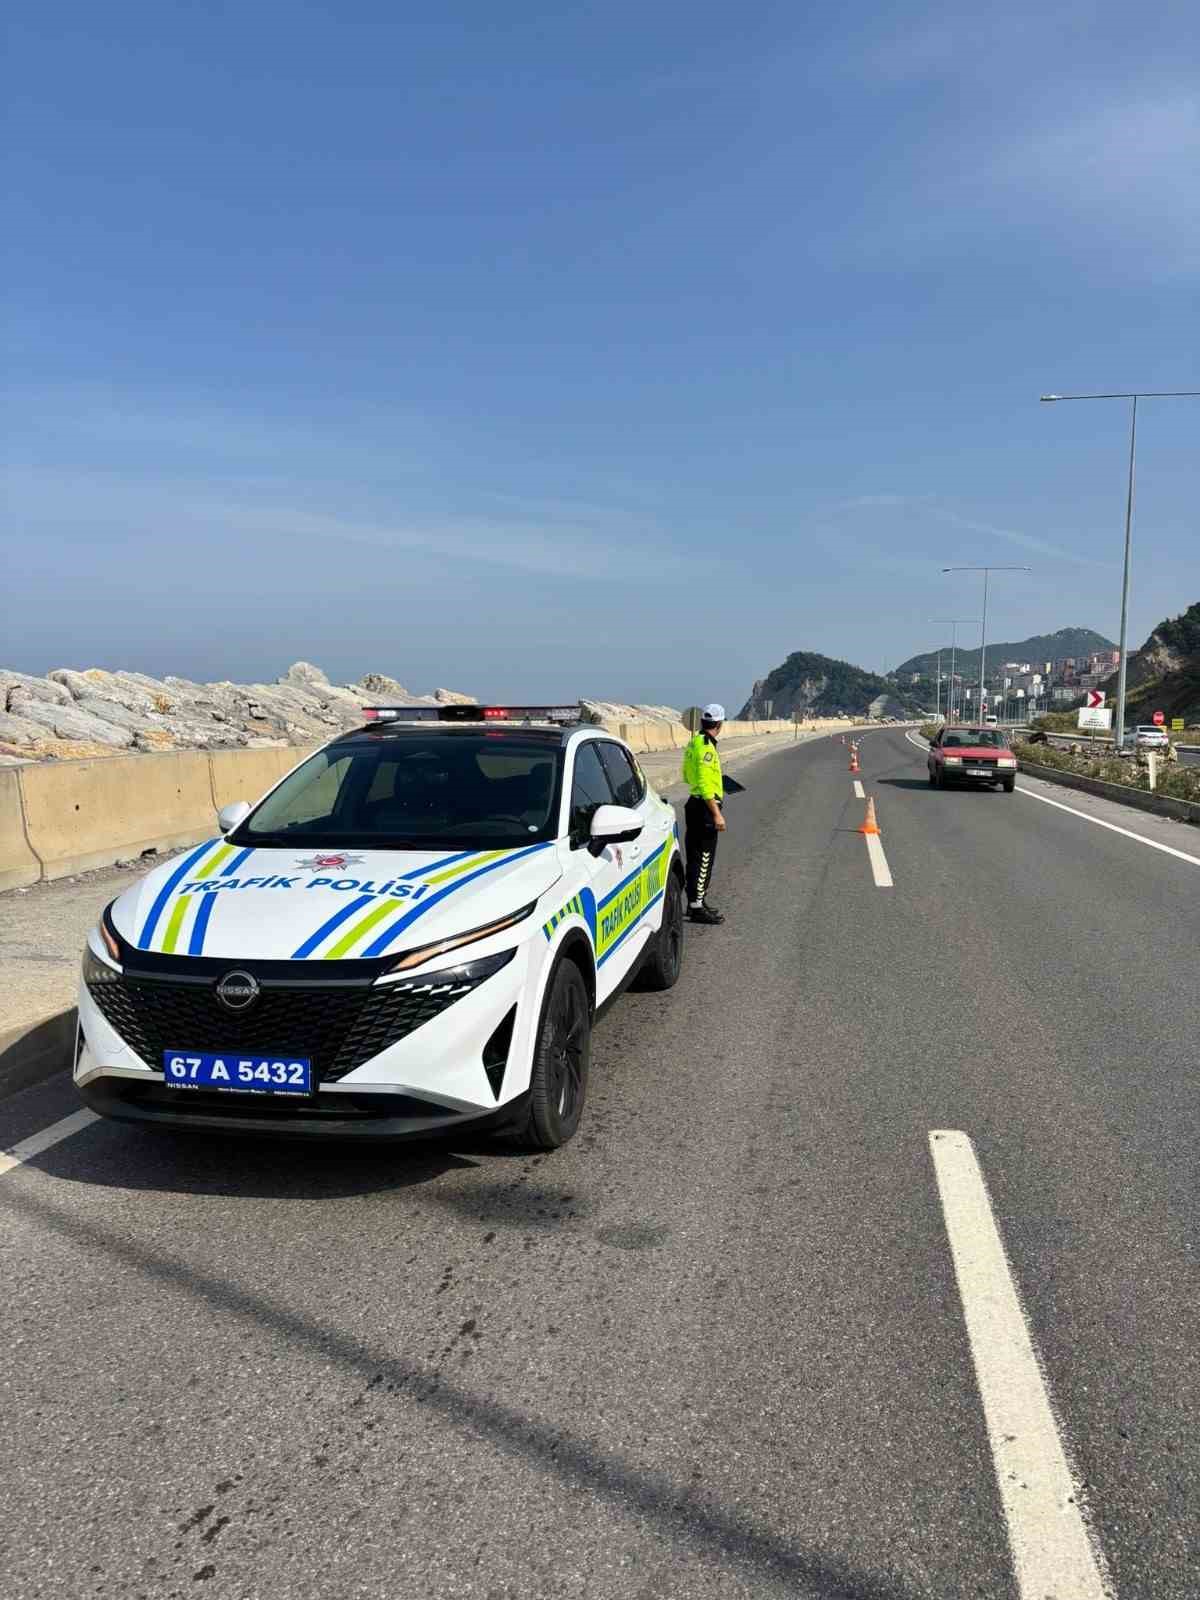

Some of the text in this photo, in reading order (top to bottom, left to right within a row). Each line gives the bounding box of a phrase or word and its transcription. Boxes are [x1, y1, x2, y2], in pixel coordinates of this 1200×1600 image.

[180, 875, 430, 899] TRAFİK POLİSİ
[602, 877, 641, 943] TRAFİK POLİSİ
[217, 985, 259, 995] NISSAN
[170, 1057, 304, 1085] 67 A 5432
[167, 1082, 199, 1090] NISSAN
